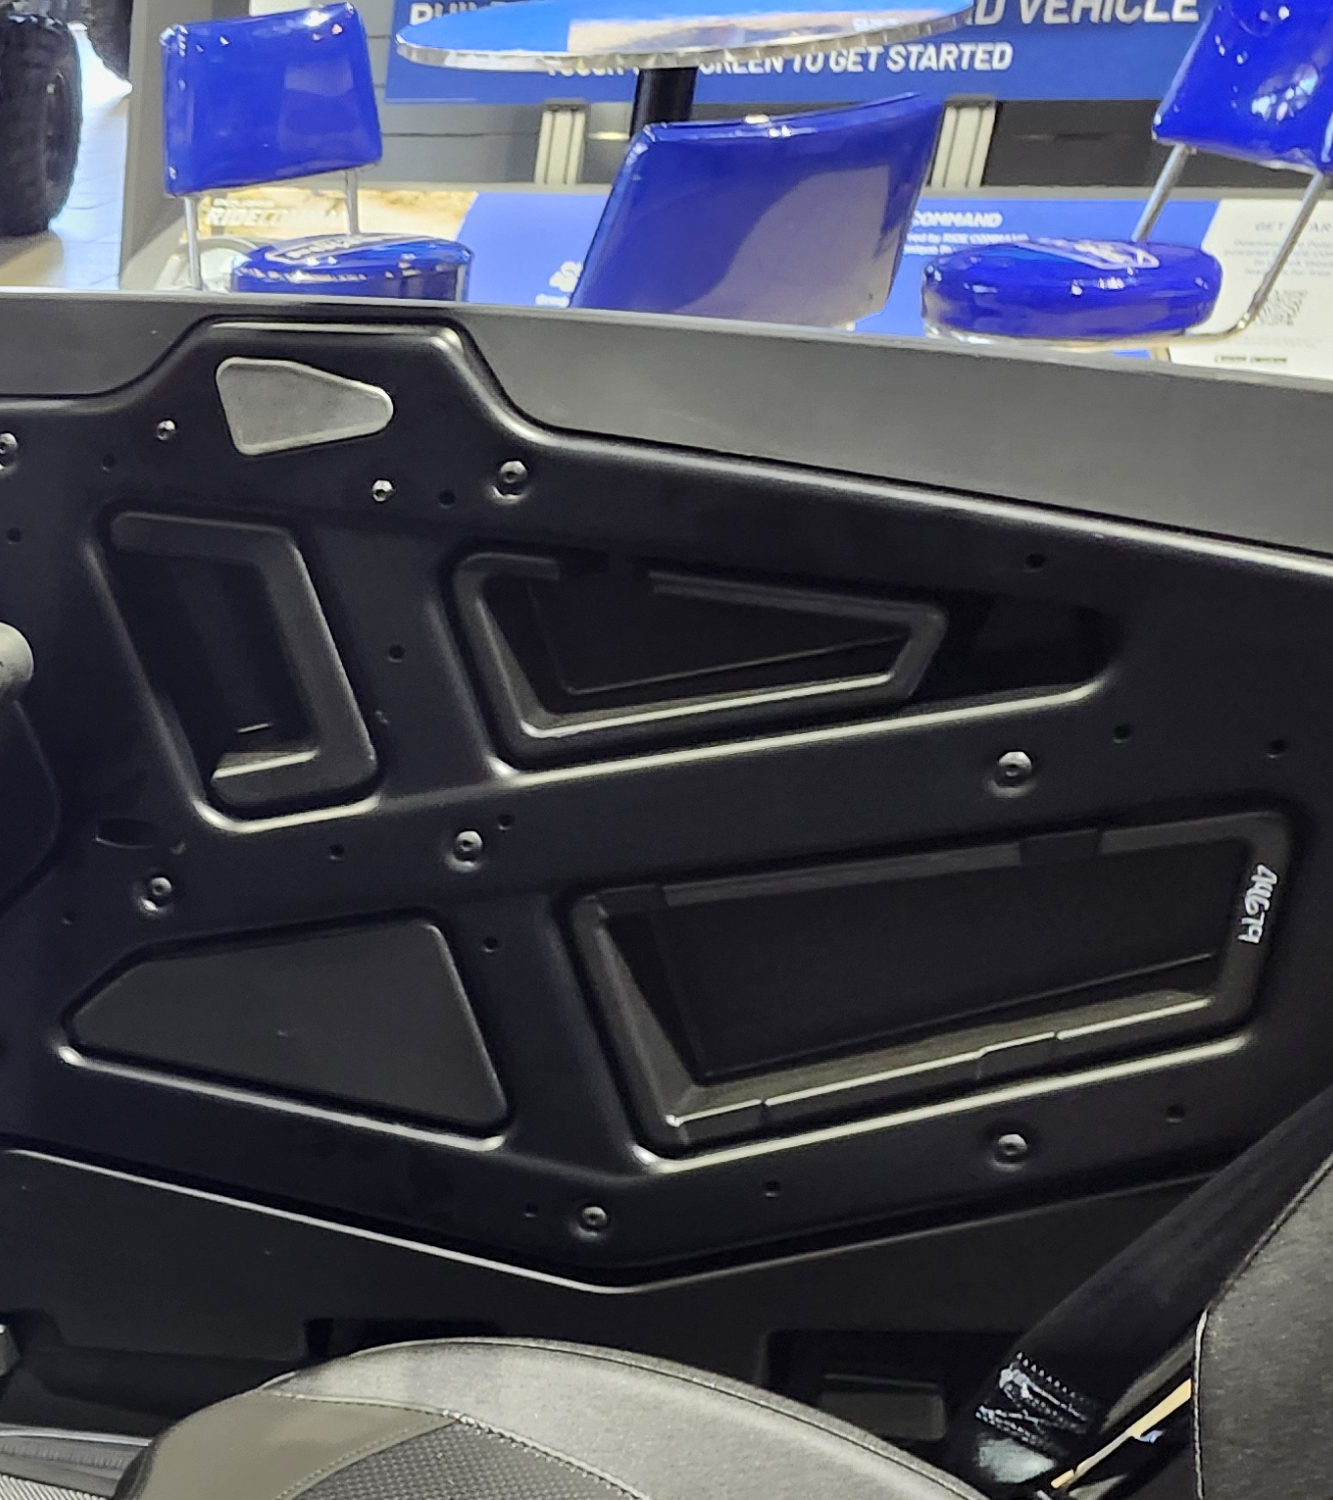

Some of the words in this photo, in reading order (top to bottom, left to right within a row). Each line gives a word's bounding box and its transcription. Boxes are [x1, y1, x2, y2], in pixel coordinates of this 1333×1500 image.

[1020, 0, 1199, 24] VEHICLE
[829, 45, 884, 73] GET
[886, 42, 1013, 72] STARTED
